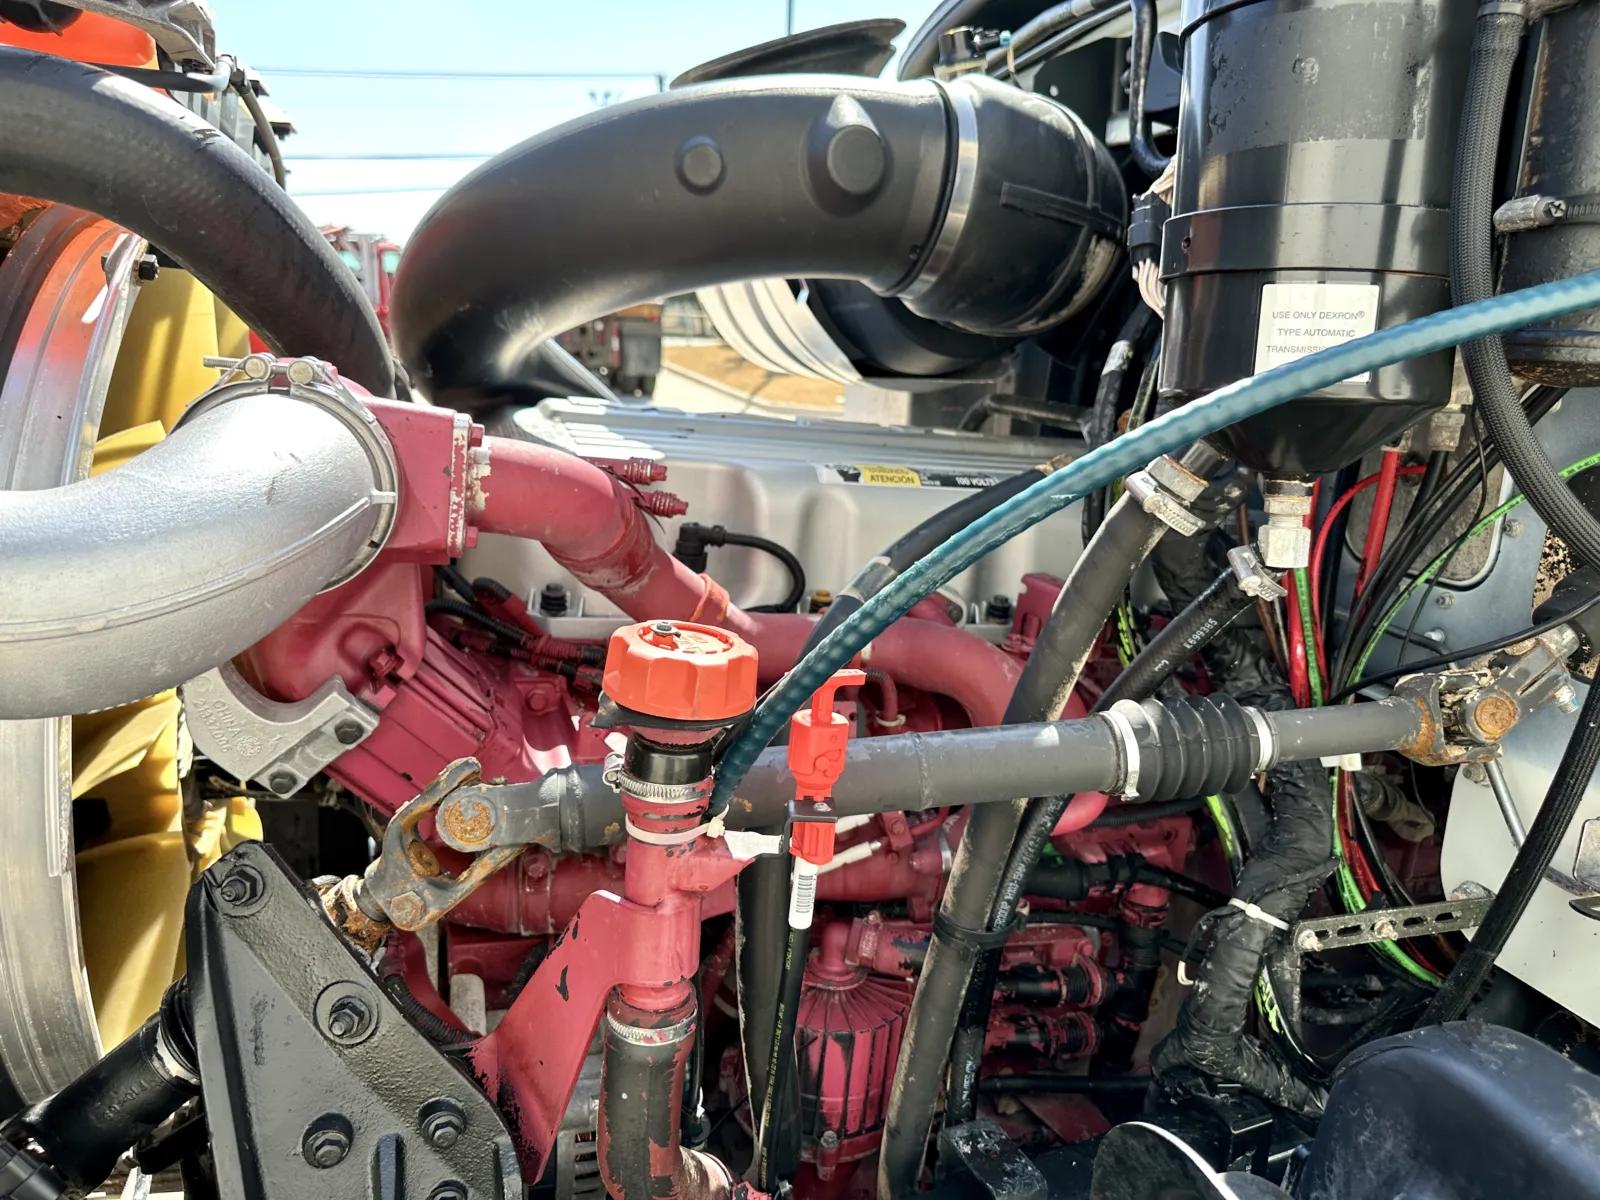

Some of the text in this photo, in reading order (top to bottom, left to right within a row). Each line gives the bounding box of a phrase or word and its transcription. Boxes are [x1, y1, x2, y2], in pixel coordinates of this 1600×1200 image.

[1272, 311, 1291, 319] USE
[1293, 311, 1317, 319] ONLY
[1277, 328, 1356, 337] TYPE AUTOMATIC
[1265, 345, 1327, 354] TRANSMISSI
[213, 700, 241, 738] CHINA
